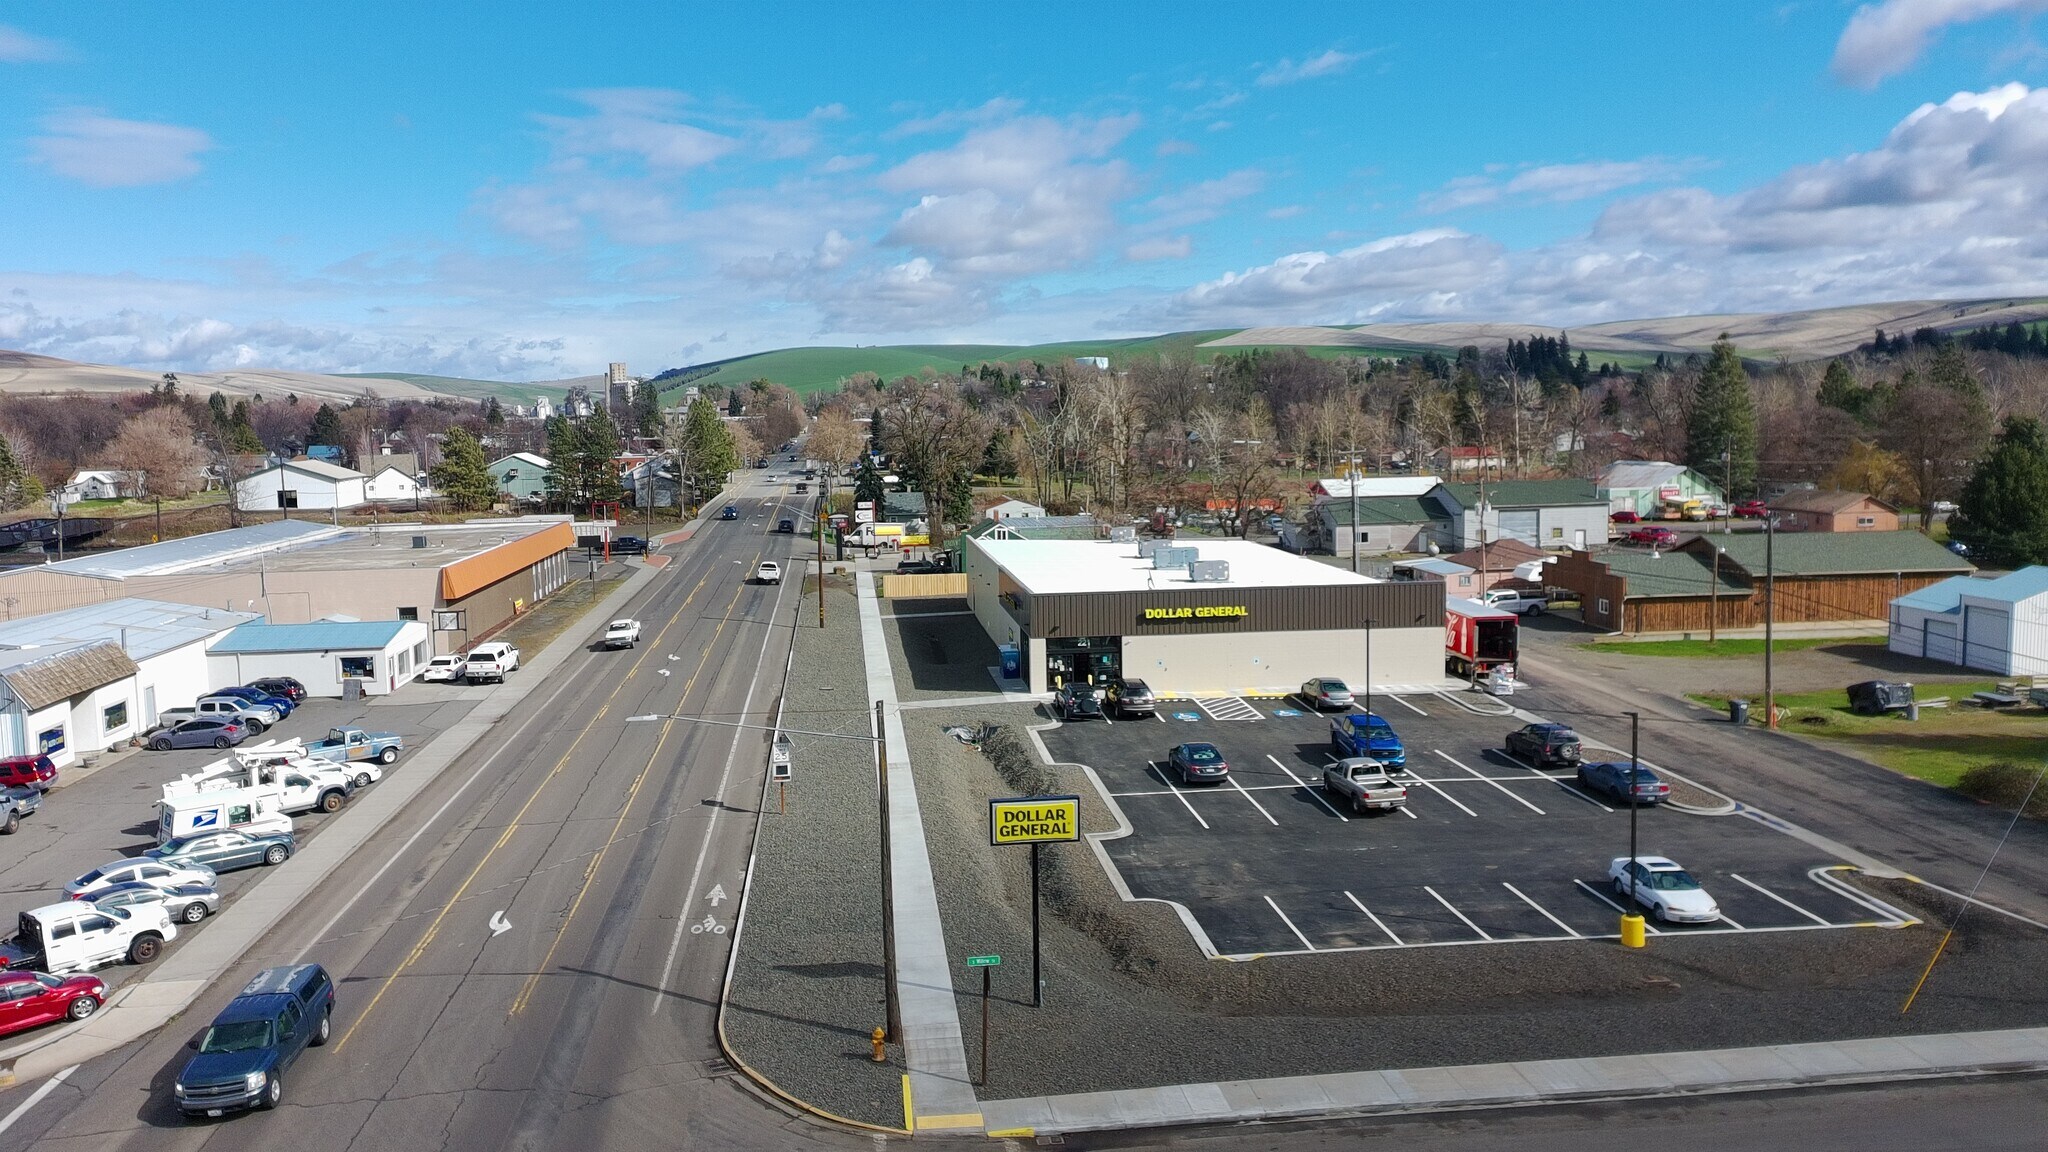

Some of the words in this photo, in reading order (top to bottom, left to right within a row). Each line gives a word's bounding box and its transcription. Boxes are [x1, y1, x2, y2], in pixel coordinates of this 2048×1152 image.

[1145, 608, 1192, 618] DOLLAR
[1195, 606, 1248, 617] GENERAL
[775, 752, 788, 761] 25
[1004, 809, 1066, 823] DOLLAR
[1000, 822, 1071, 837] GENERAL
